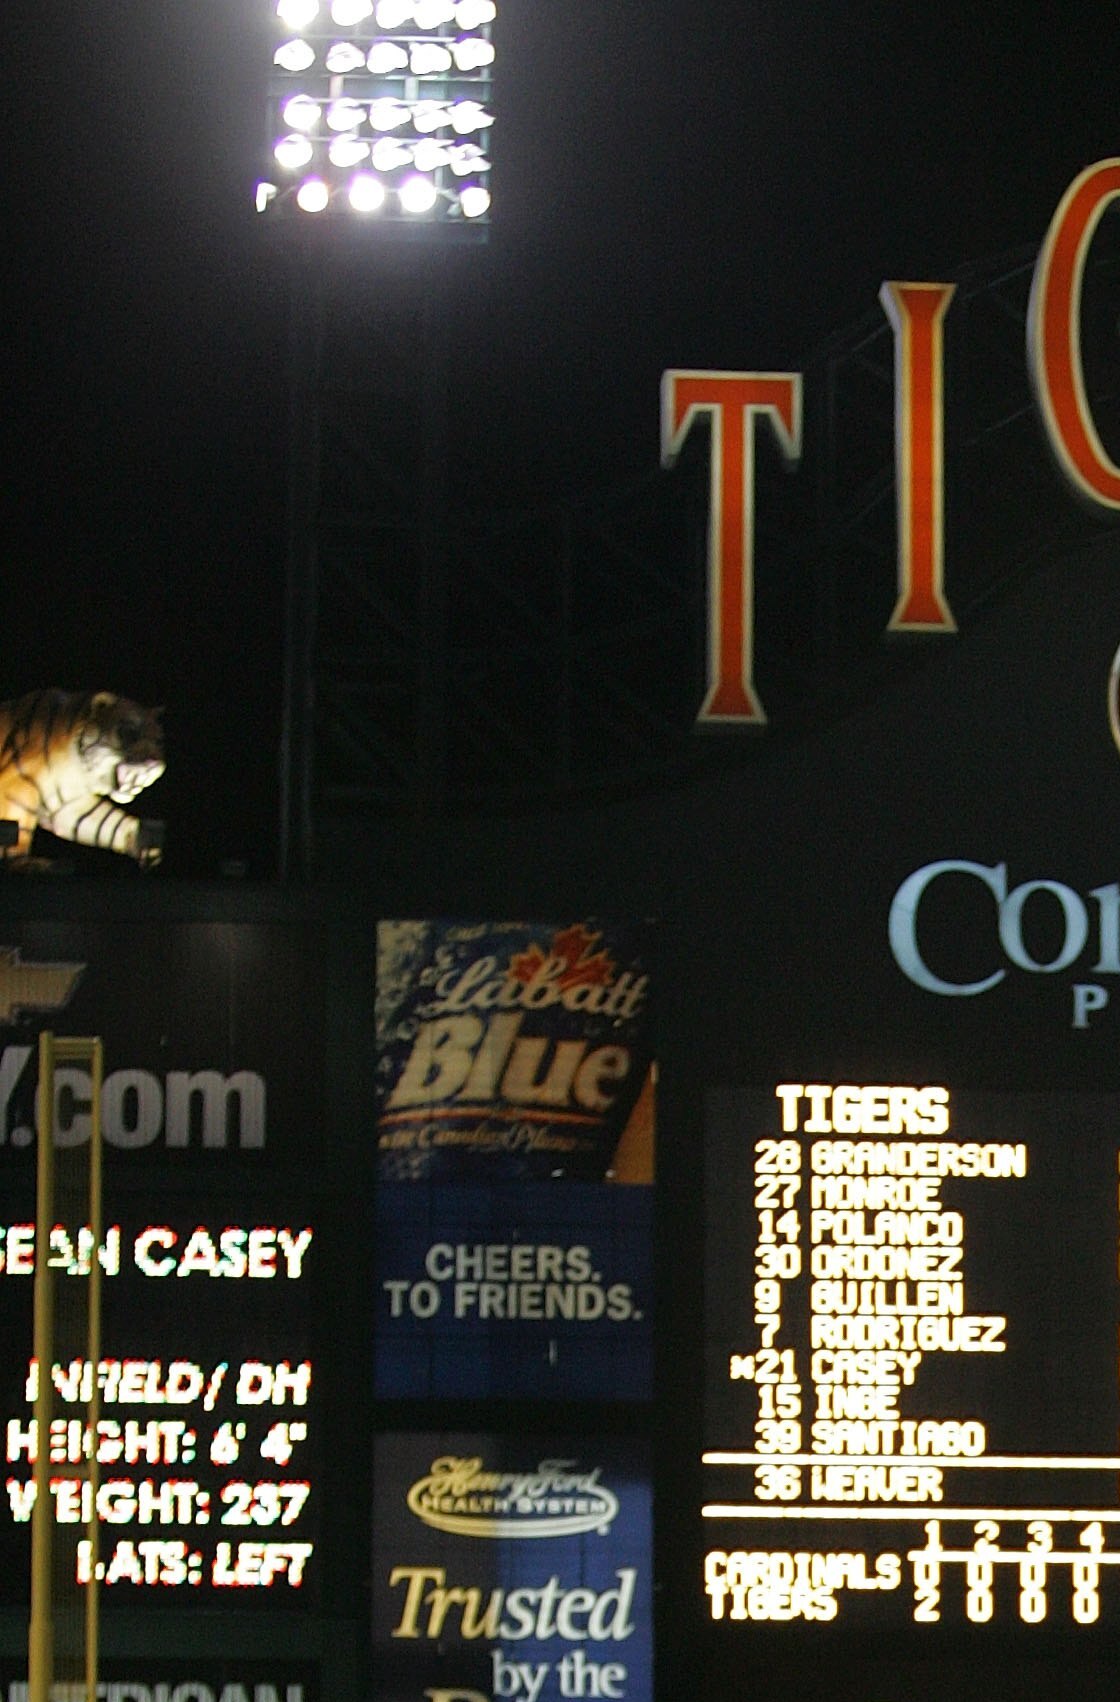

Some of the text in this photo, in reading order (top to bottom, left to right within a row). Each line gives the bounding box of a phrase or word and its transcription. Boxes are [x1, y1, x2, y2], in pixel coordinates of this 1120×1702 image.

[415, 953, 648, 1018] Labatt
[386, 1011, 631, 1112] Blue
[776, 1085, 949, 1135] TIGERS
[754, 1139, 801, 1174] 28
[811, 1141, 1026, 1177] GRANDERSON
[754, 1175, 801, 1209] 27
[811, 1176, 942, 1211] MONROE
[758, 1210, 800, 1244] 14
[811, 1210, 964, 1247] POLANCO
[0, 1224, 312, 1278] EAN CASEY
[425, 1244, 601, 1283] CHEERS.
[754, 1245, 801, 1279] 30
[811, 1246, 964, 1281] ORDONEZ
[384, 1282, 643, 1321] TO FRIENDS.
[754, 1281, 780, 1313] 9
[811, 1281, 964, 1316] GUILLEN
[754, 1314, 780, 1348] 7
[811, 1315, 1006, 1352] RODRIGUEZ
[236, 1361, 311, 1405] DH
[811, 1350, 922, 1385] CASEY
[757, 1383, 801, 1419] 15
[814, 1384, 900, 1420] INGE
[6, 1419, 197, 1464] HEIGHT:
[210, 1420, 247, 1466] 6'
[754, 1420, 801, 1455] 39
[811, 1420, 986, 1456] SANTIAGO
[754, 1464, 801, 1500] 36
[811, 1465, 943, 1502] WEAVER
[220, 1480, 310, 1526] 237
[420, 1496, 607, 1515] HEALTH SYSTEM
[973, 1521, 1000, 1552] 2
[1026, 1522, 1054, 1552] 3
[1079, 1522, 1106, 1554] 4
[212, 1542, 313, 1587] LEFT
[704, 1551, 901, 1590] CARDINALS
[389, 1567, 637, 1641] Trusted
[705, 1586, 838, 1621] TIGERS
[914, 1591, 940, 1622] 2
[557, 1651, 625, 1699] the
